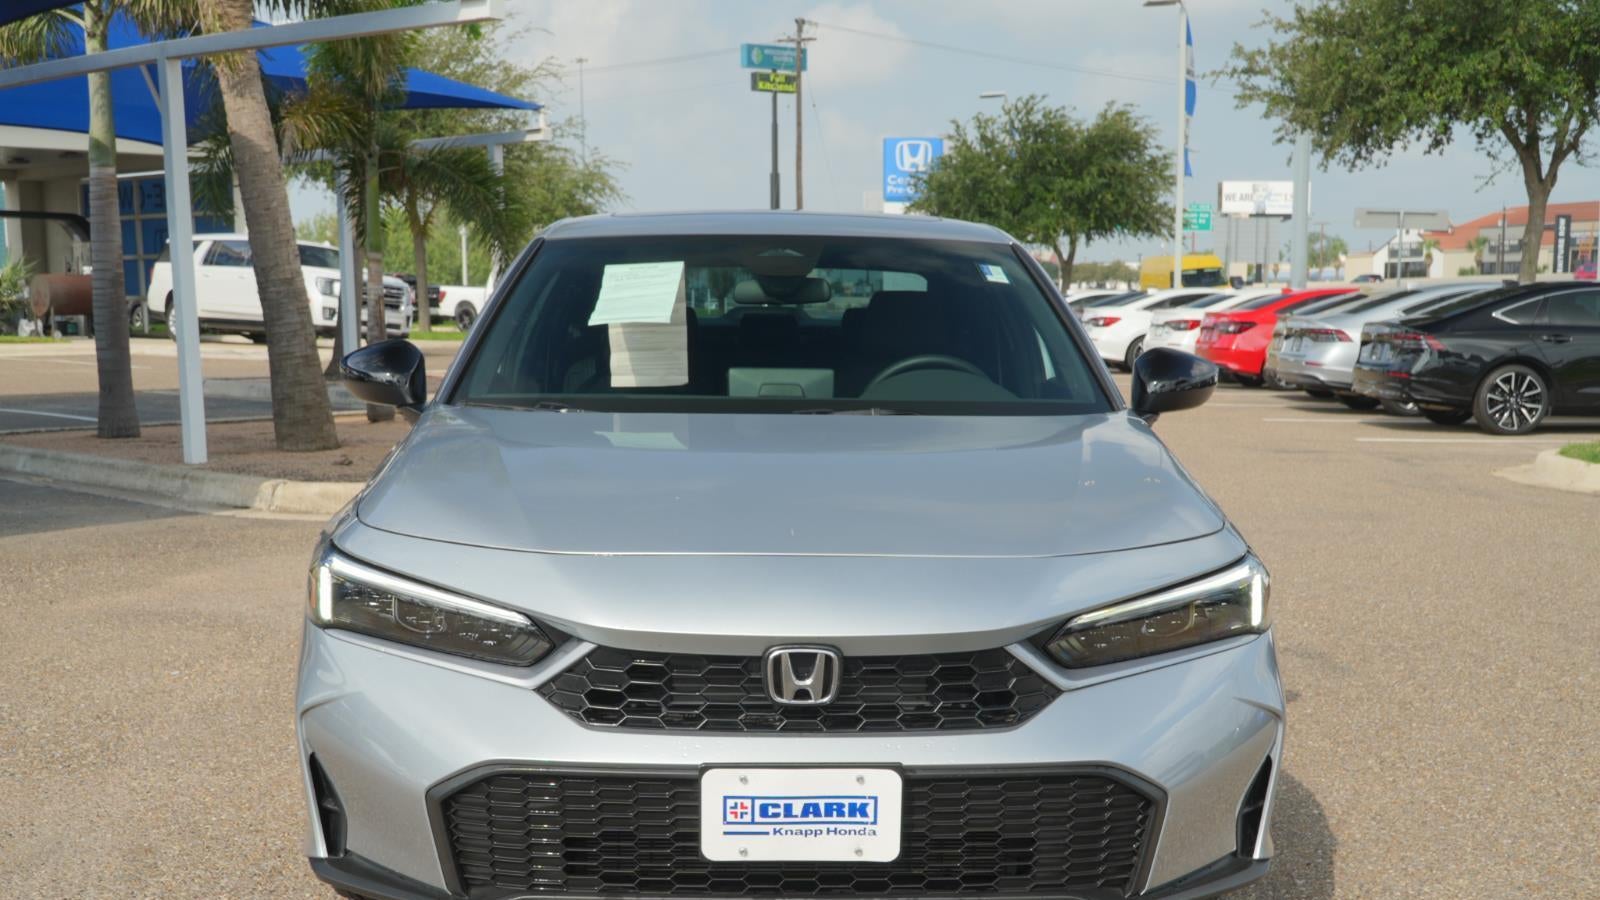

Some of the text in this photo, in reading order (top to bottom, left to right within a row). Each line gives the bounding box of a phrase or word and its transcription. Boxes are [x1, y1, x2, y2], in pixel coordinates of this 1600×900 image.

[759, 802, 870, 819] CLARK
[773, 827, 877, 837] Knapp Honda
